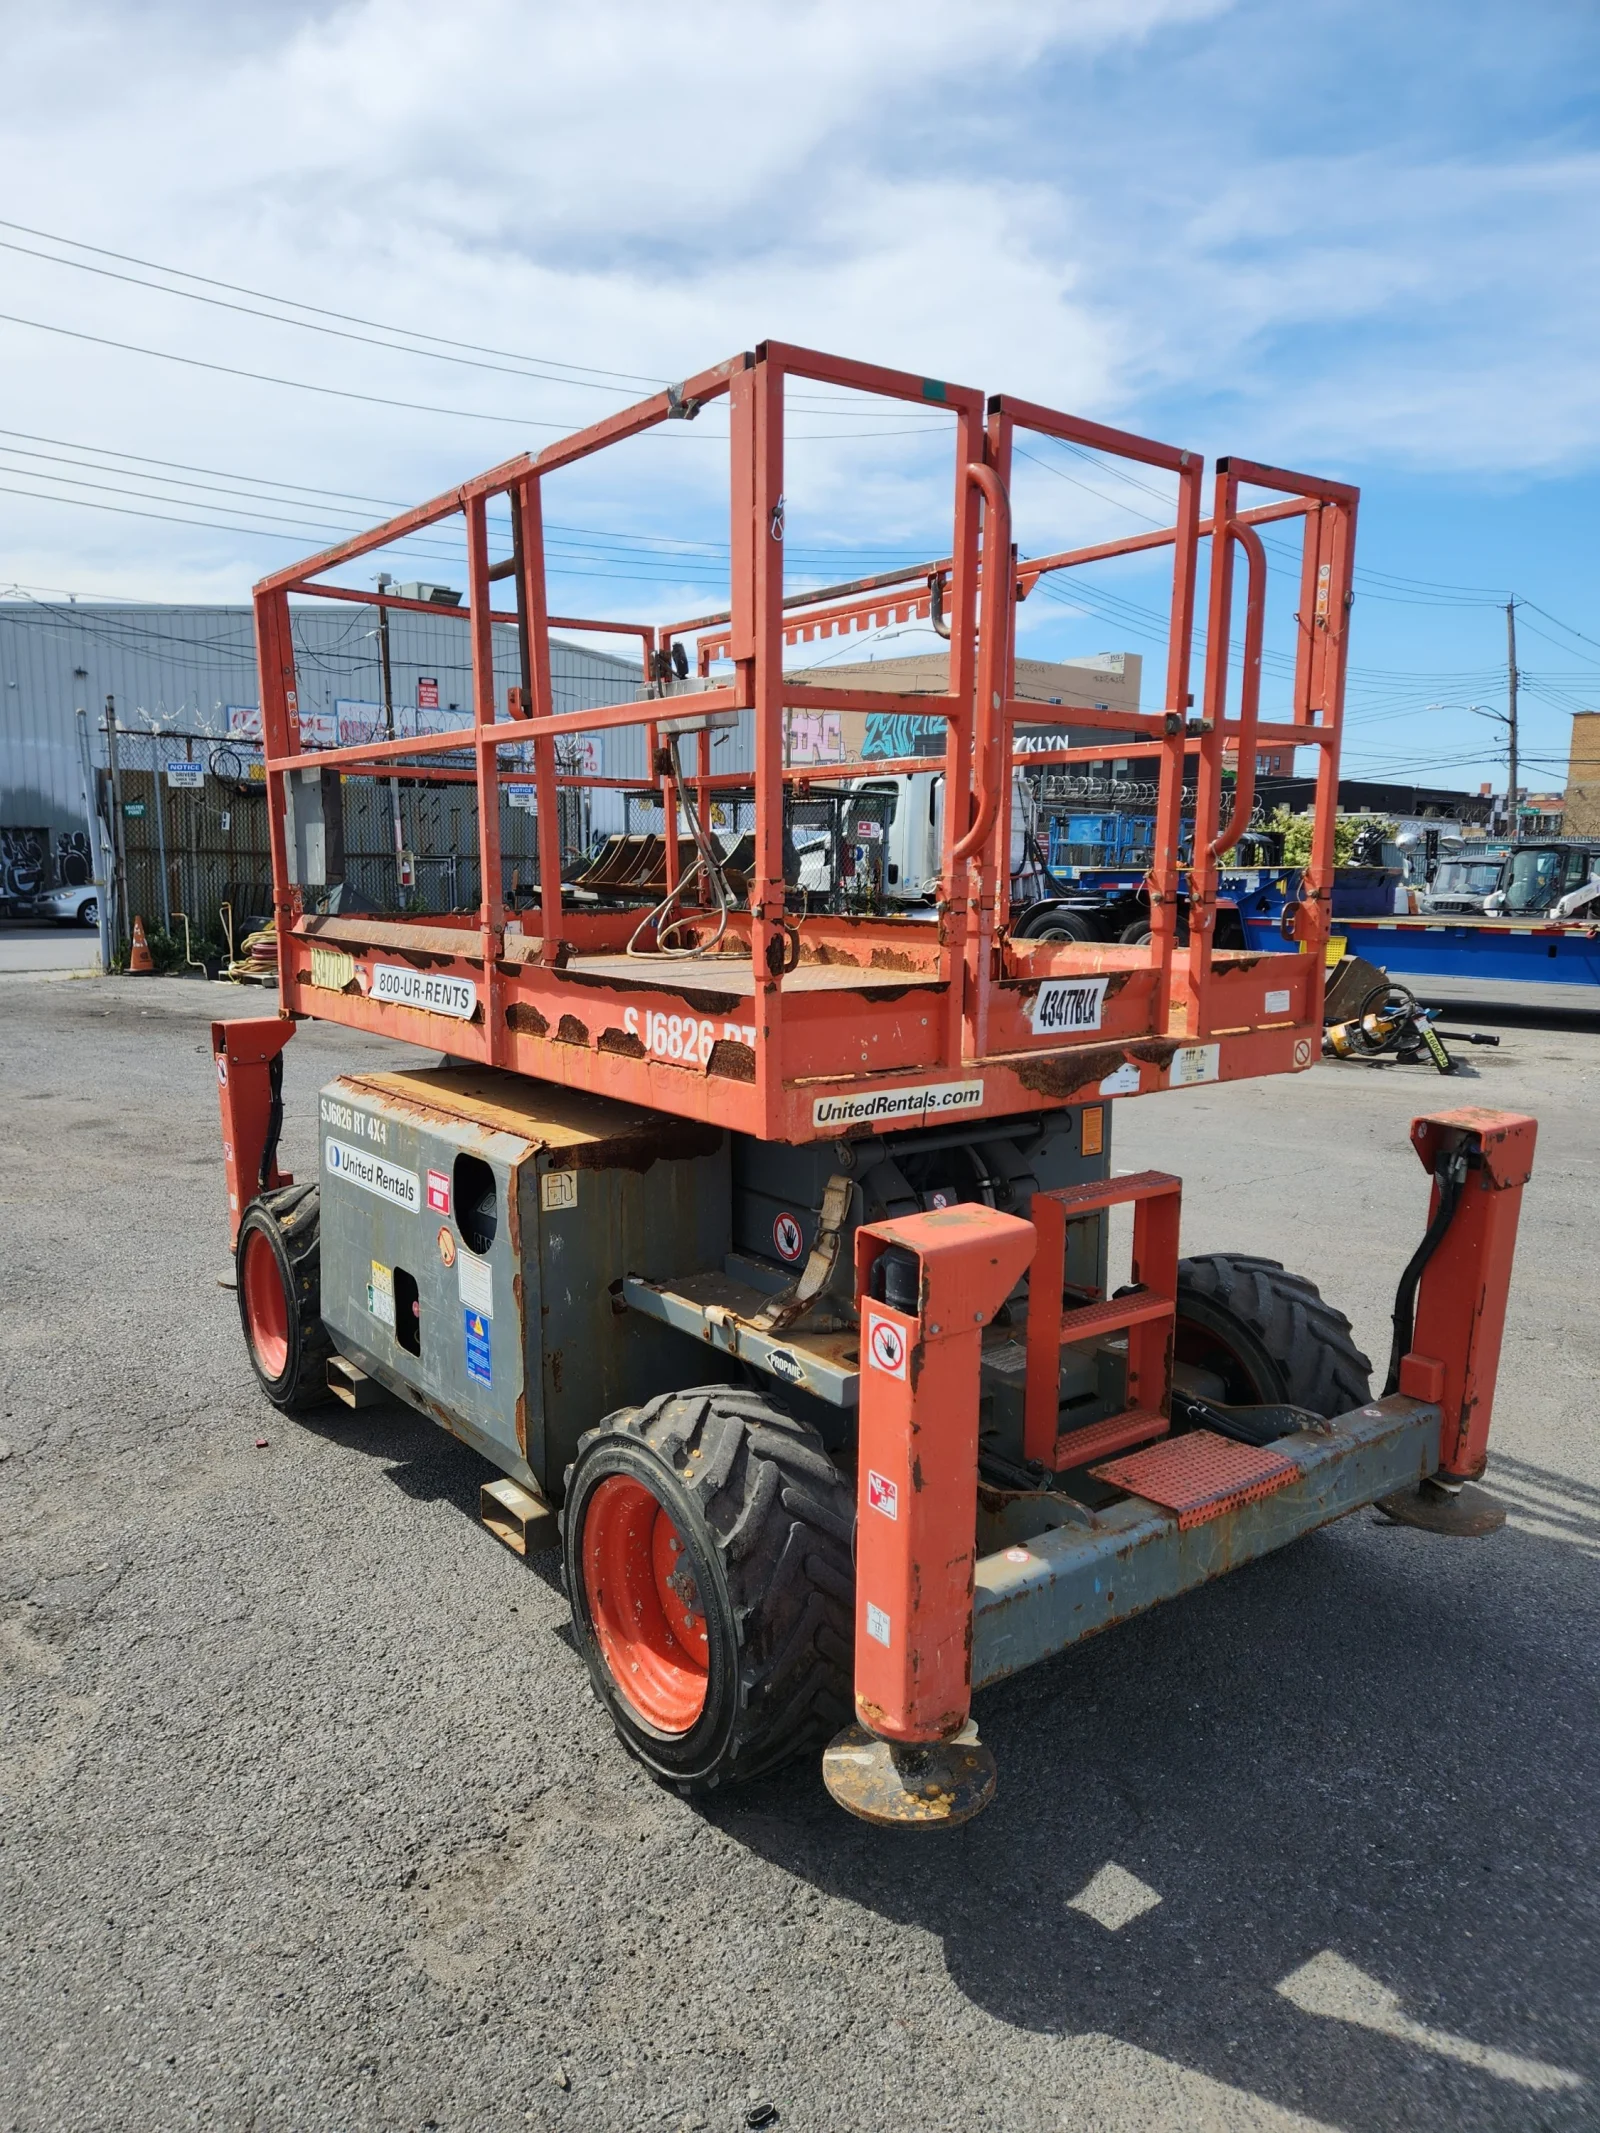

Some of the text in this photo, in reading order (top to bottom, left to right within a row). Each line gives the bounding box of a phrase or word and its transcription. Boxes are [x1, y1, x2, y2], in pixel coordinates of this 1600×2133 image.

[1014, 735, 1069, 752] KLYN
[379, 973, 469, 1009] 800-UR-RENTS
[1040, 988, 1099, 1027] 43477BLA
[624, 1006, 714, 1066] SJ6826
[321, 1099, 387, 1145] SJ6826 RT 4X4
[817, 1089, 980, 1122] UnitedRentals.com
[342, 1153, 373, 1183] United
[375, 1165, 415, 1202] Rentals
[770, 1354, 801, 1378] PROPANE
